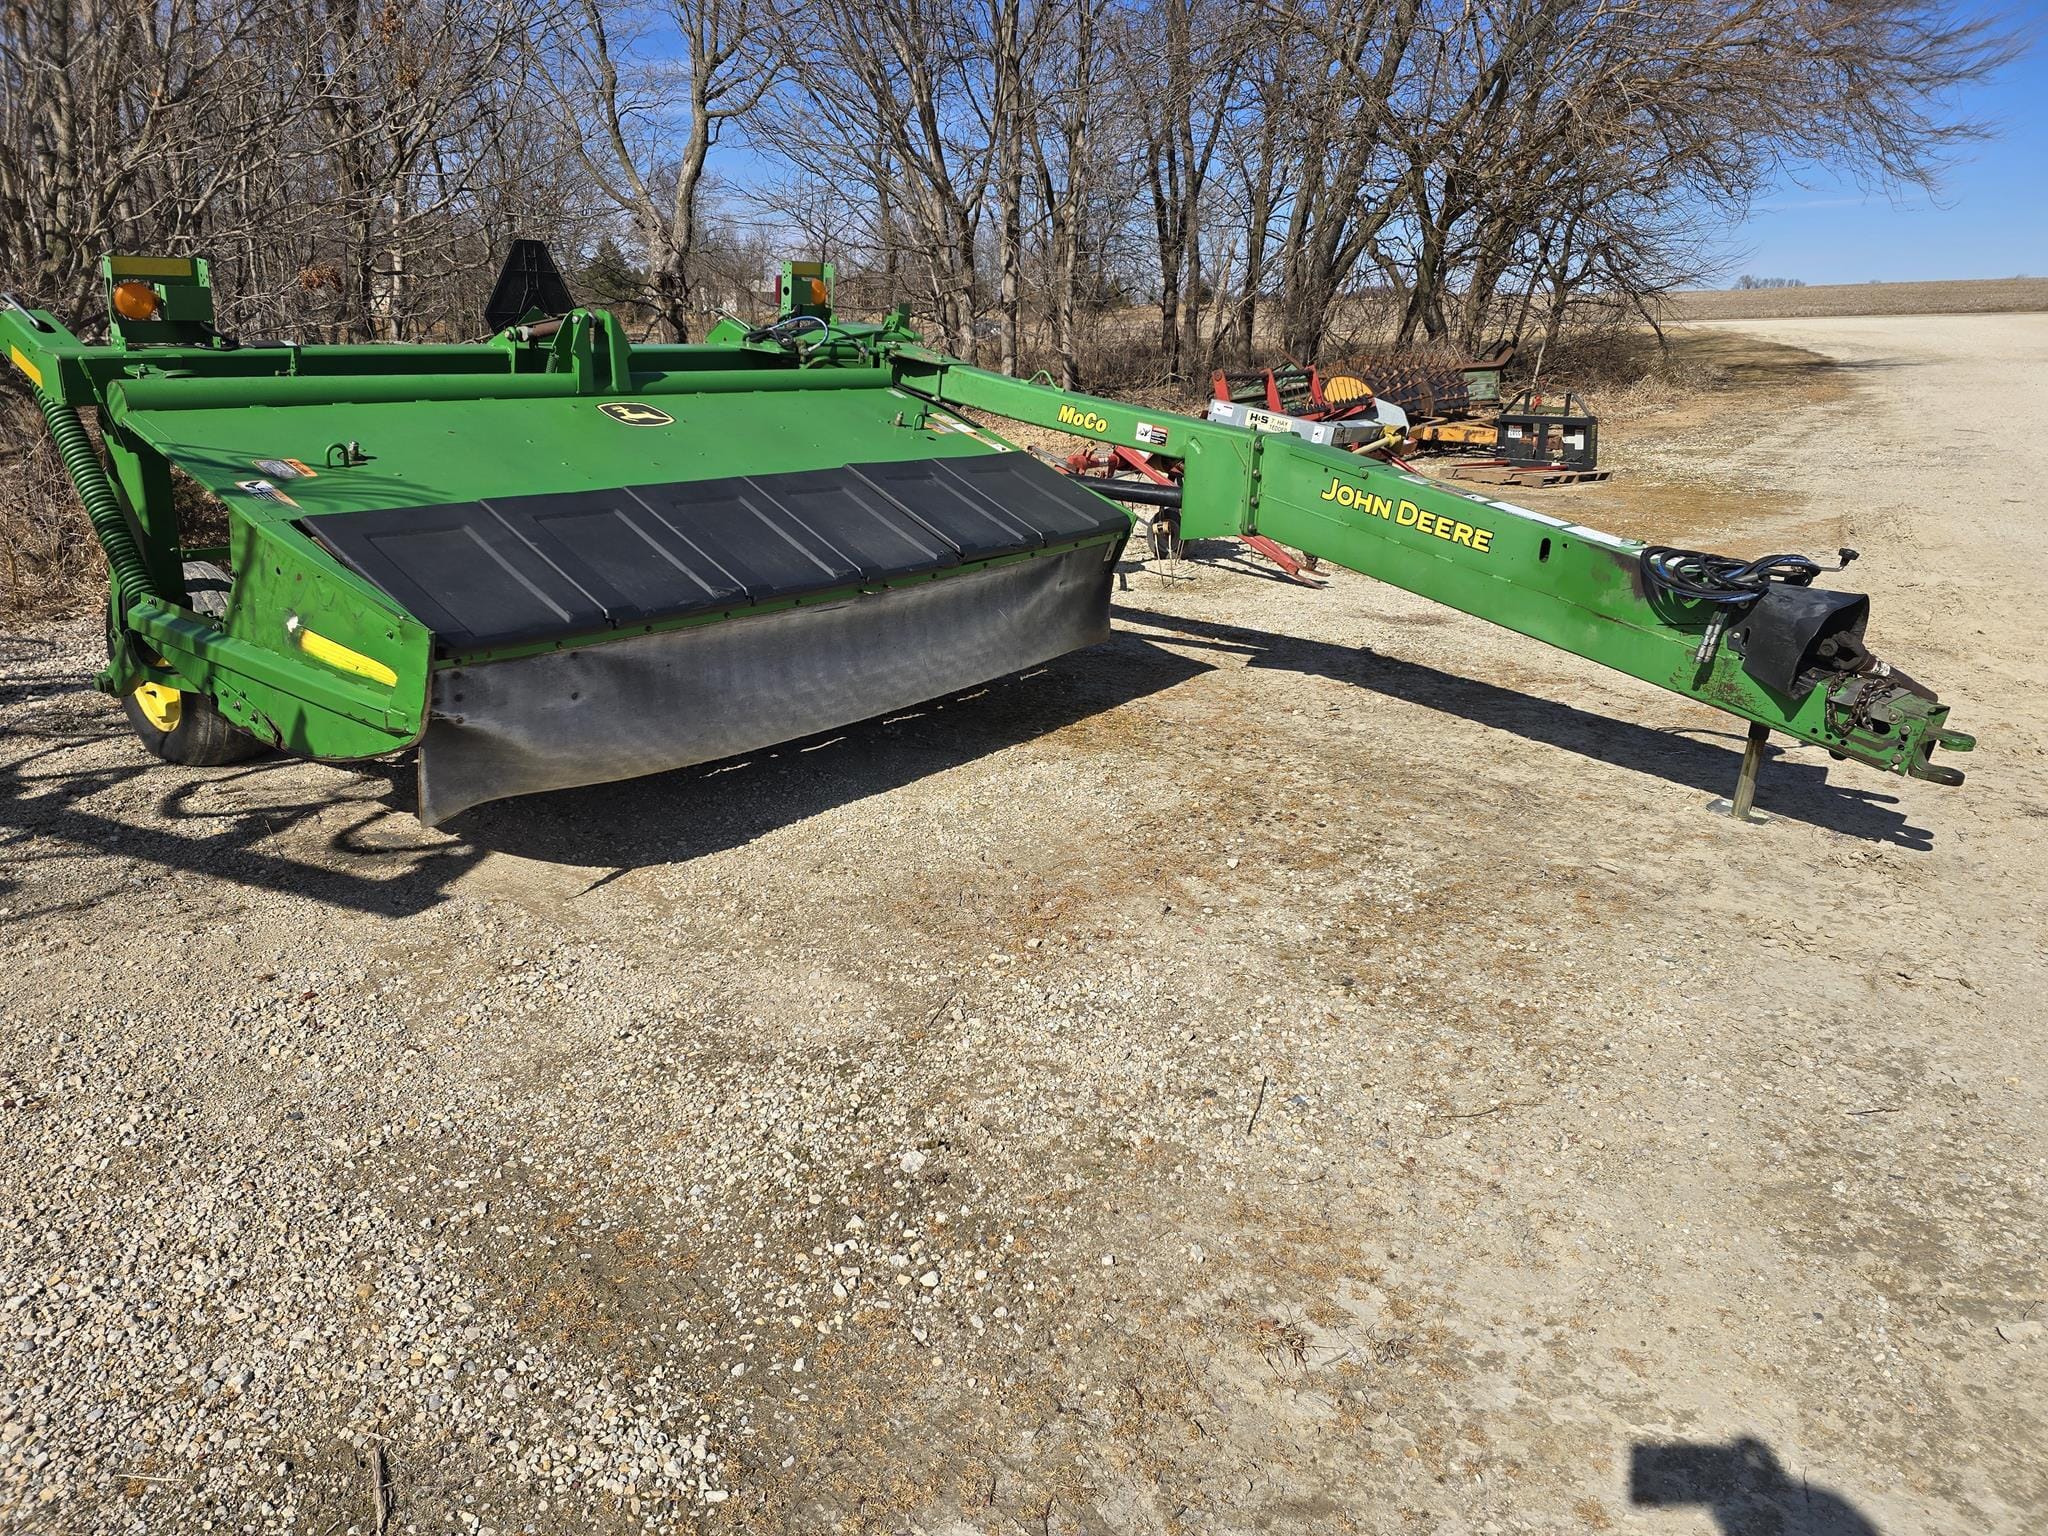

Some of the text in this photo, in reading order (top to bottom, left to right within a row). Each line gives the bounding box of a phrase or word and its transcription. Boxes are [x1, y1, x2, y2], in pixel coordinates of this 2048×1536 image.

[1057, 404, 1108, 433] MoCo
[1250, 413, 1269, 424] H&S
[1321, 477, 1495, 553] JOHN DEERE
